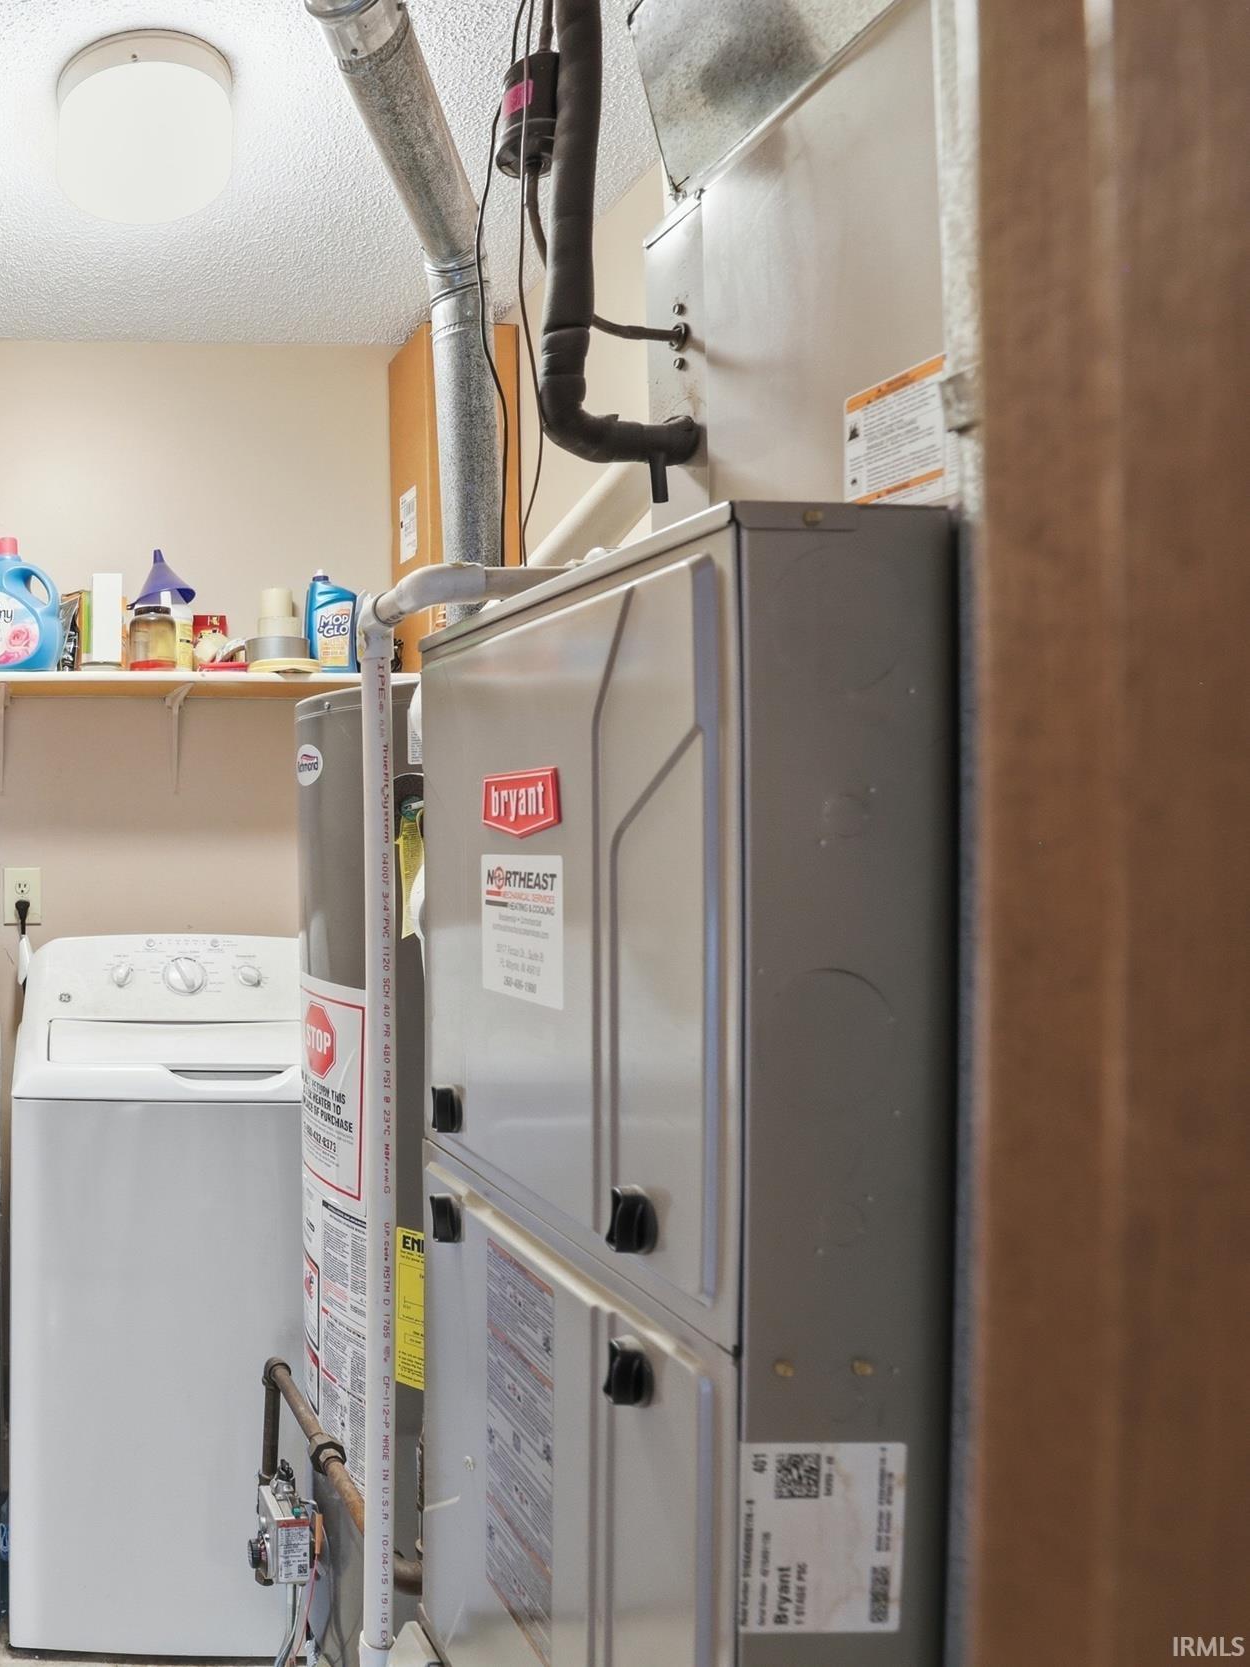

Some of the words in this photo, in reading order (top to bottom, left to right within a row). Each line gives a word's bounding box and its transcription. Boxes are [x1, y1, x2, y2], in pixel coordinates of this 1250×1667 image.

[320, 614, 349, 627] MOP
[323, 625, 349, 637] GLO
[491, 781, 545, 822] bryant
[486, 866, 558, 892] NORTHEAST
[383, 1003, 391, 1018] 40
[306, 1023, 332, 1055] STOP
[383, 1023, 391, 1038] PR
[383, 1043, 391, 1064] 480
[383, 1069, 391, 1090] PSI
[331, 1089, 346, 1105] THIS
[332, 1104, 342, 1116] TO
[320, 1109, 353, 1134] PURCHASE
[383, 1265, 391, 1293] ASTM
[383, 1298, 391, 1306] D
[382, 1434, 390, 1461] MADE
[752, 1453, 768, 1473] 401
[382, 1469, 390, 1481] IN
[382, 1487, 390, 1525] U.S.A.
[773, 1566, 792, 1626] Bryant
